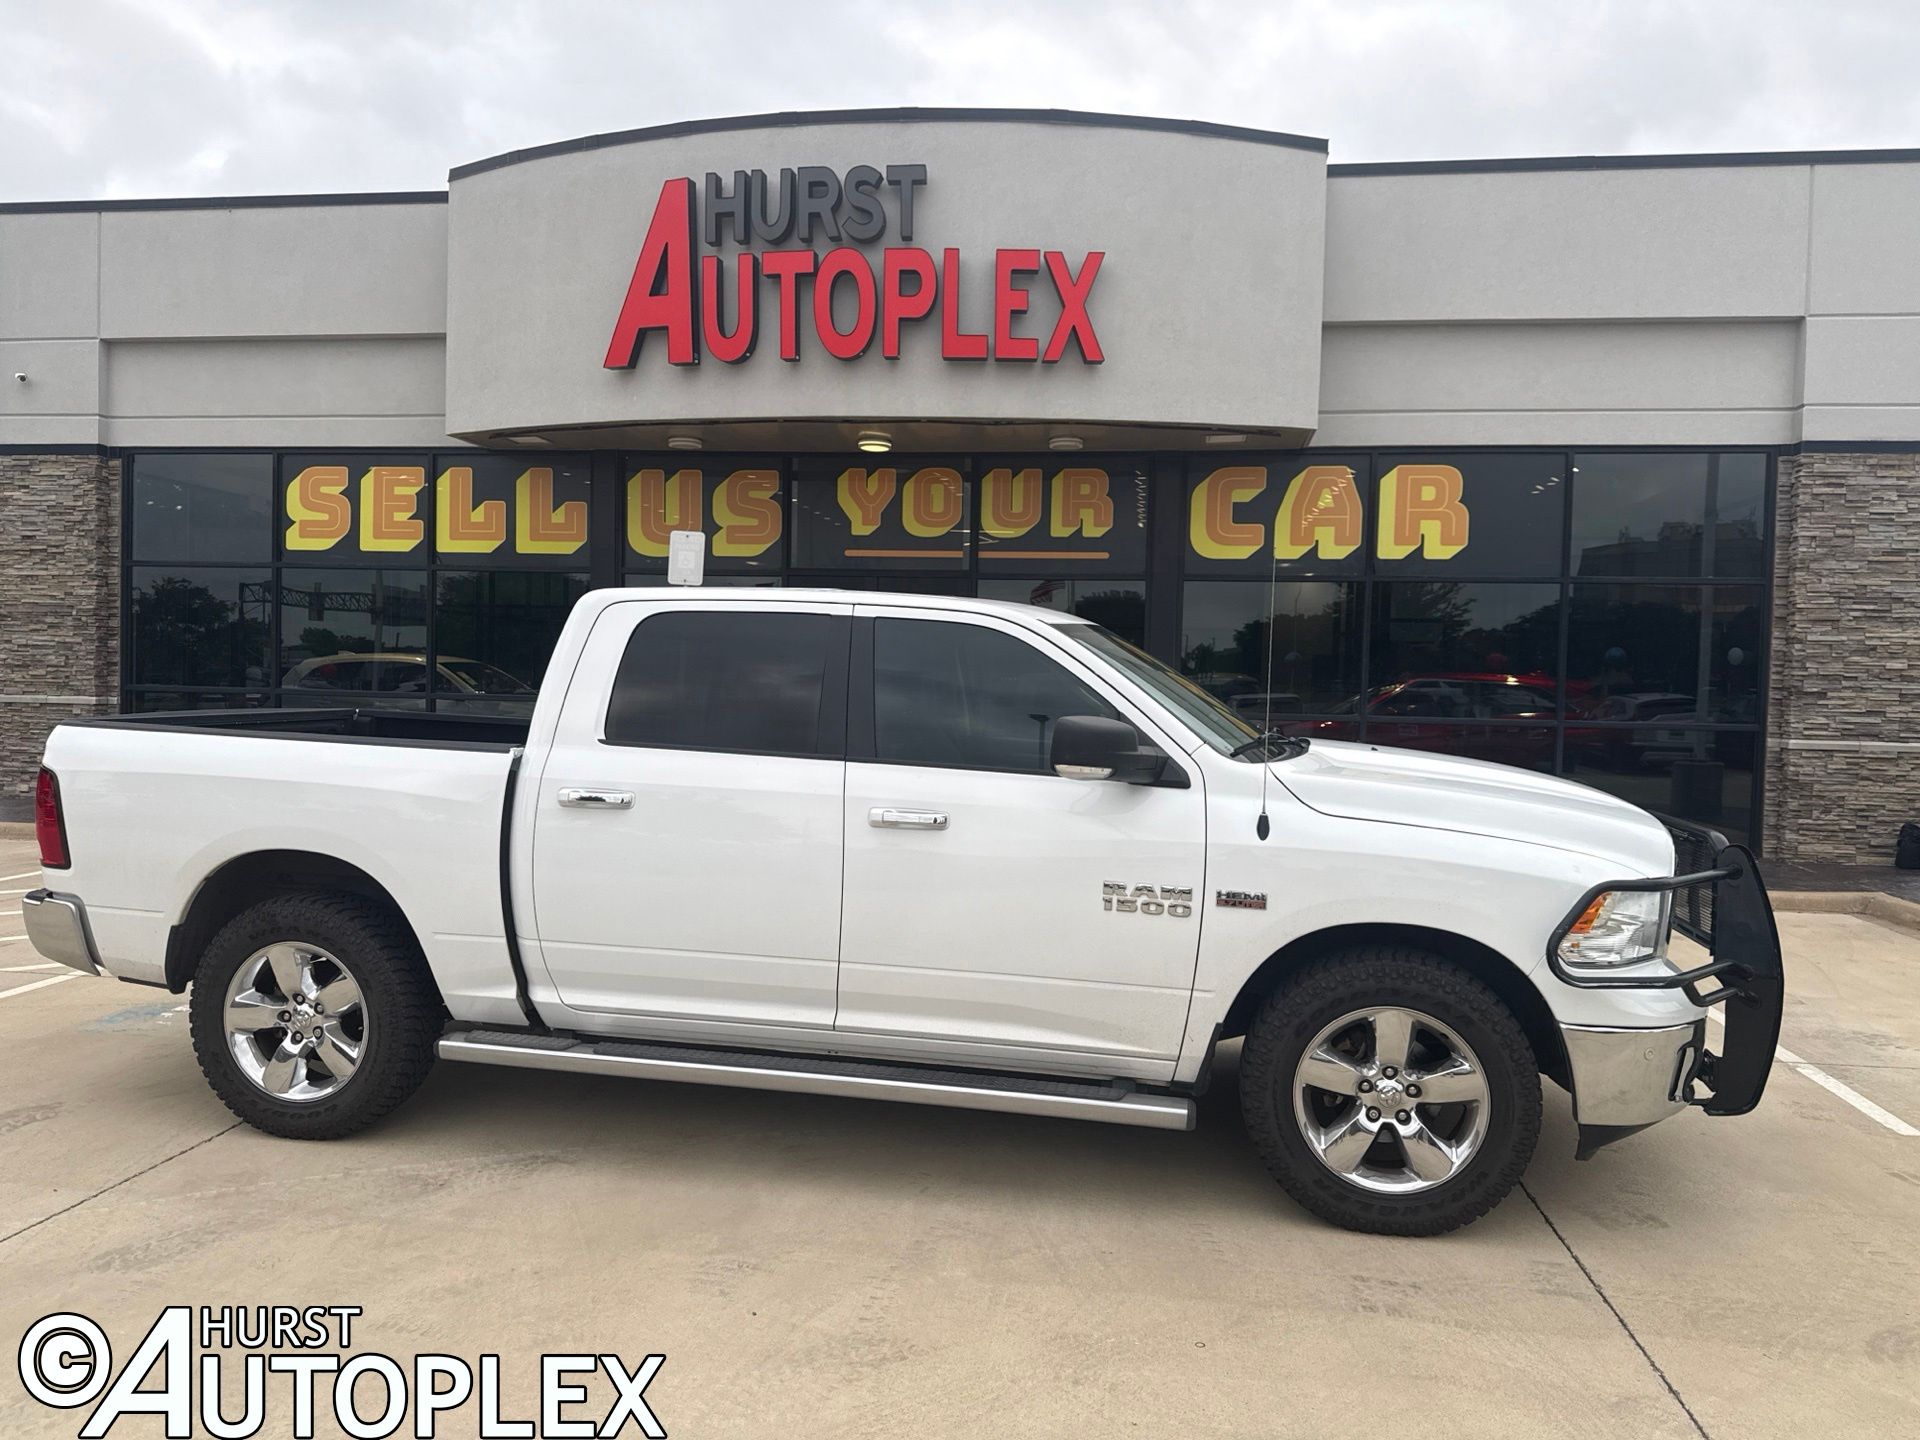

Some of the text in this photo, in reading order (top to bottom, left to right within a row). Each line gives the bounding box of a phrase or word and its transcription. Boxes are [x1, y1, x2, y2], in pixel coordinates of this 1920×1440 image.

[704, 164, 927, 247] HURST
[603, 176, 1106, 371] AUTOPLEX
[285, 464, 1470, 560] SELL US YOUR CAR
[1102, 880, 1193, 902] RAM
[1102, 896, 1193, 918] 1500
[1215, 889, 1269, 902] HEMI
